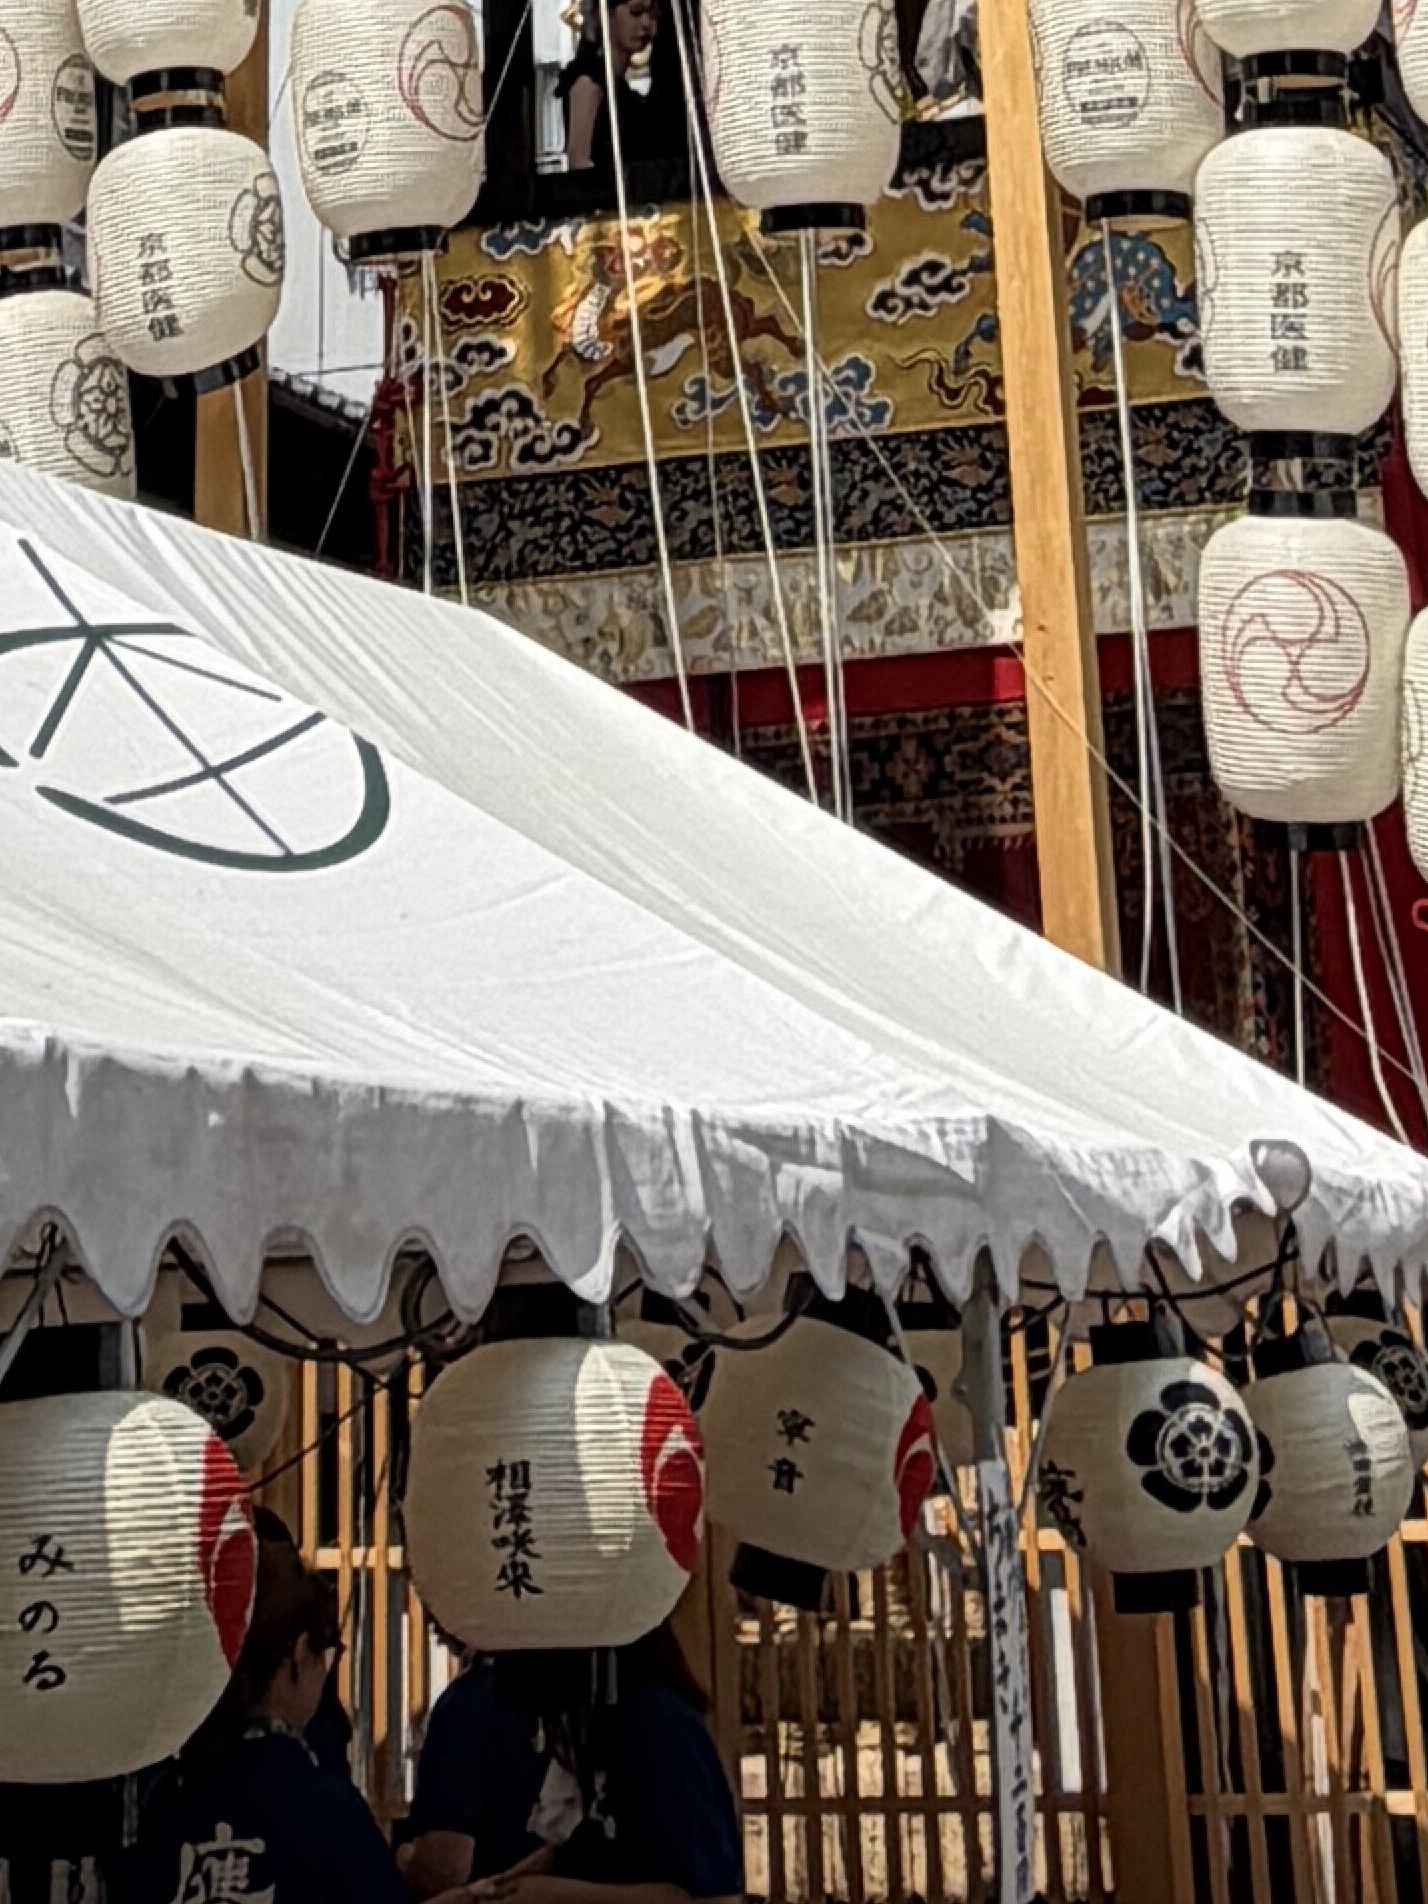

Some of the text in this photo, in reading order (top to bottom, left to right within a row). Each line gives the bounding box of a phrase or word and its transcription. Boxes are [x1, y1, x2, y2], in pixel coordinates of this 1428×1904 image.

[1270, 251, 1308, 371] 京都医健
[18, 1534, 74, 1692] みのる
